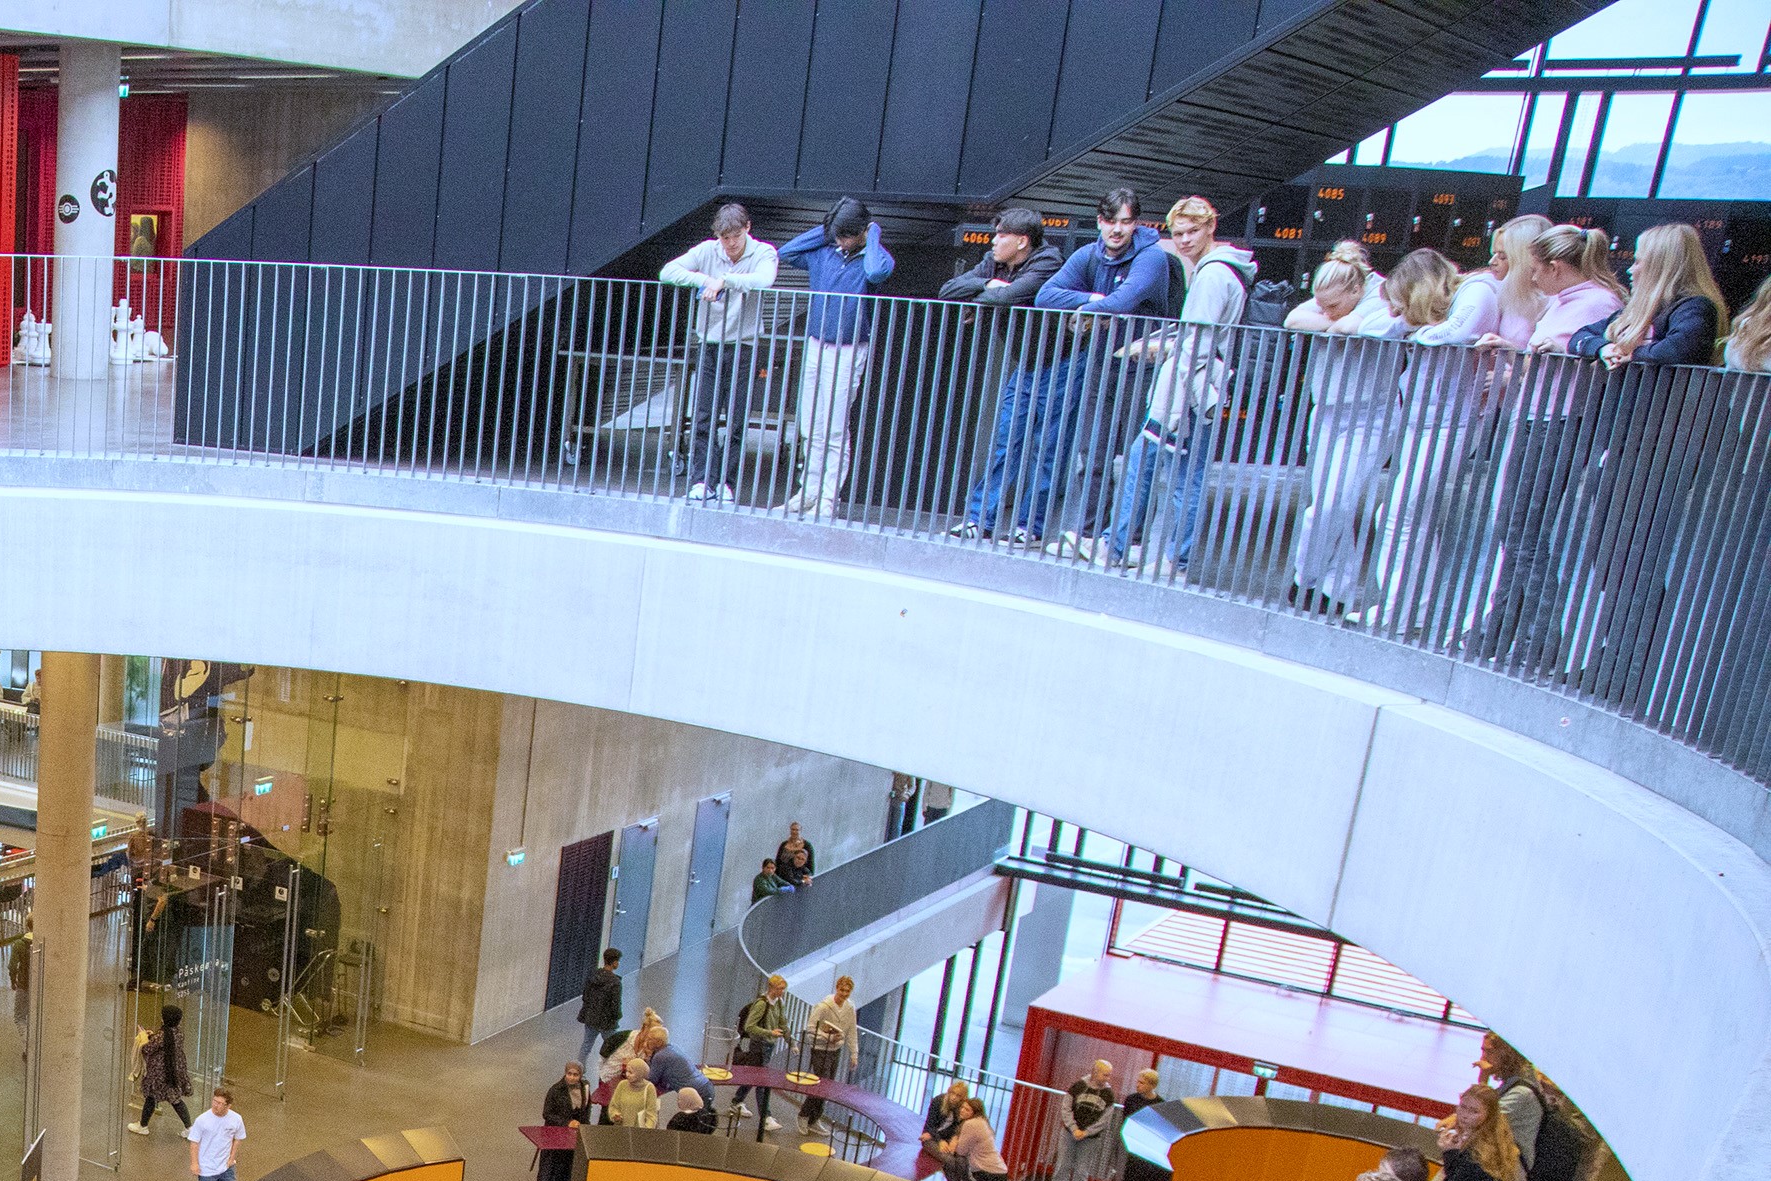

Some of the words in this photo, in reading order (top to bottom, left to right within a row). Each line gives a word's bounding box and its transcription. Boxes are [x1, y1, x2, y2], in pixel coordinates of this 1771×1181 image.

[1318, 187, 1345, 200] 4085
[963, 231, 990, 245] 4066
[1274, 227, 1303, 239] 4081
[1362, 233, 1387, 244] 4089
